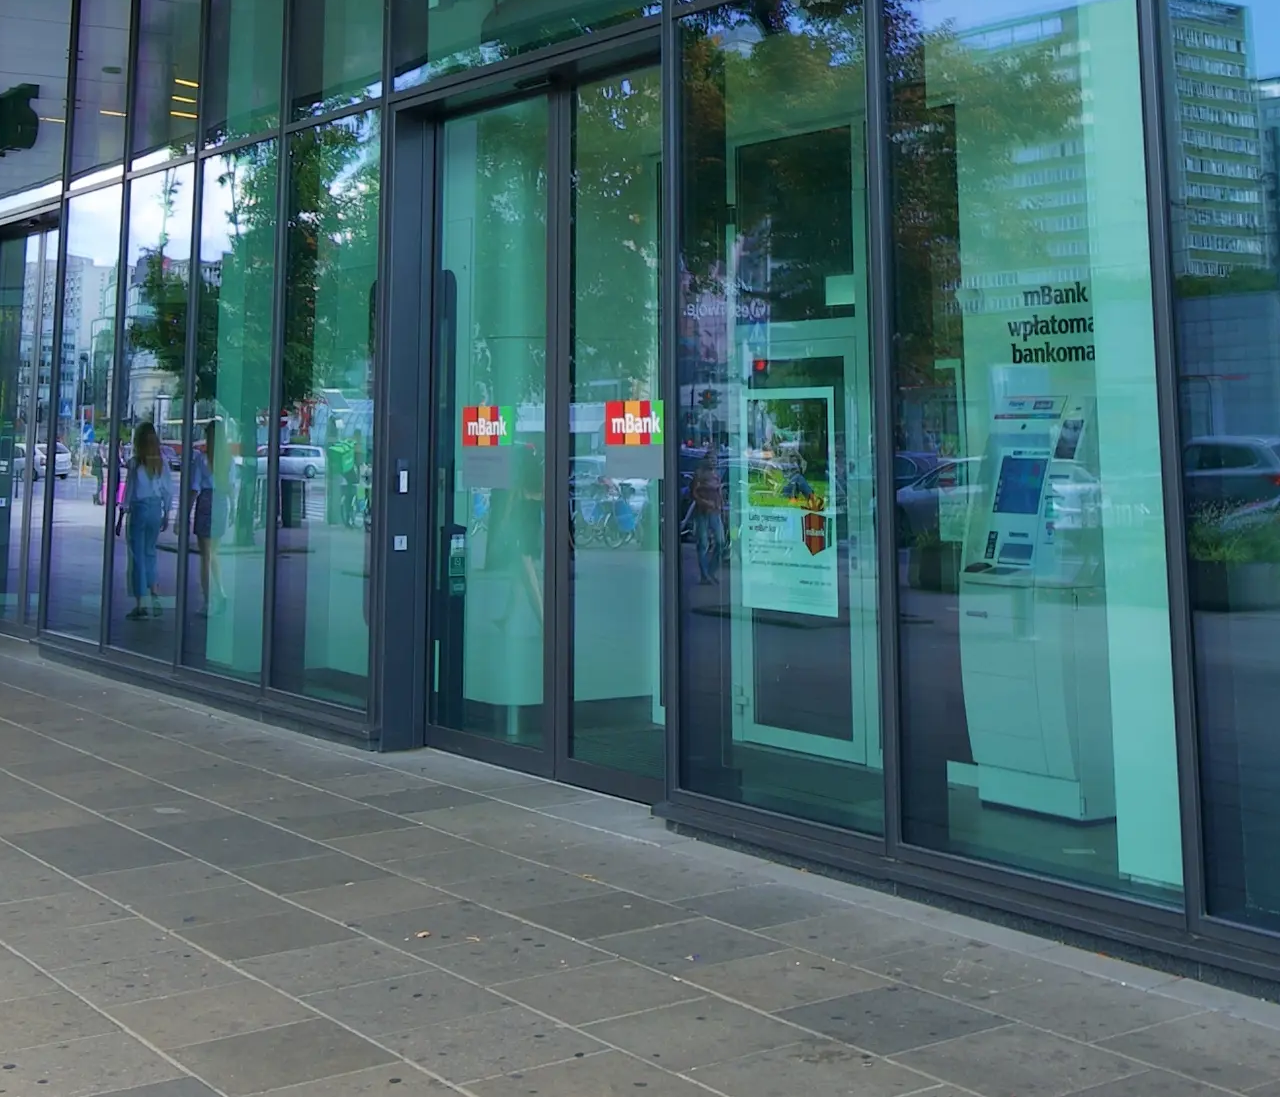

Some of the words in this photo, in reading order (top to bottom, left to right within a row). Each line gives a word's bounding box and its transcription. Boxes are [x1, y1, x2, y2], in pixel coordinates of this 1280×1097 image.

[1022, 281, 1089, 306] mBank
[1011, 342, 1096, 364] bankoma
[467, 415, 507, 436] mBank
[612, 411, 661, 434] mBank
